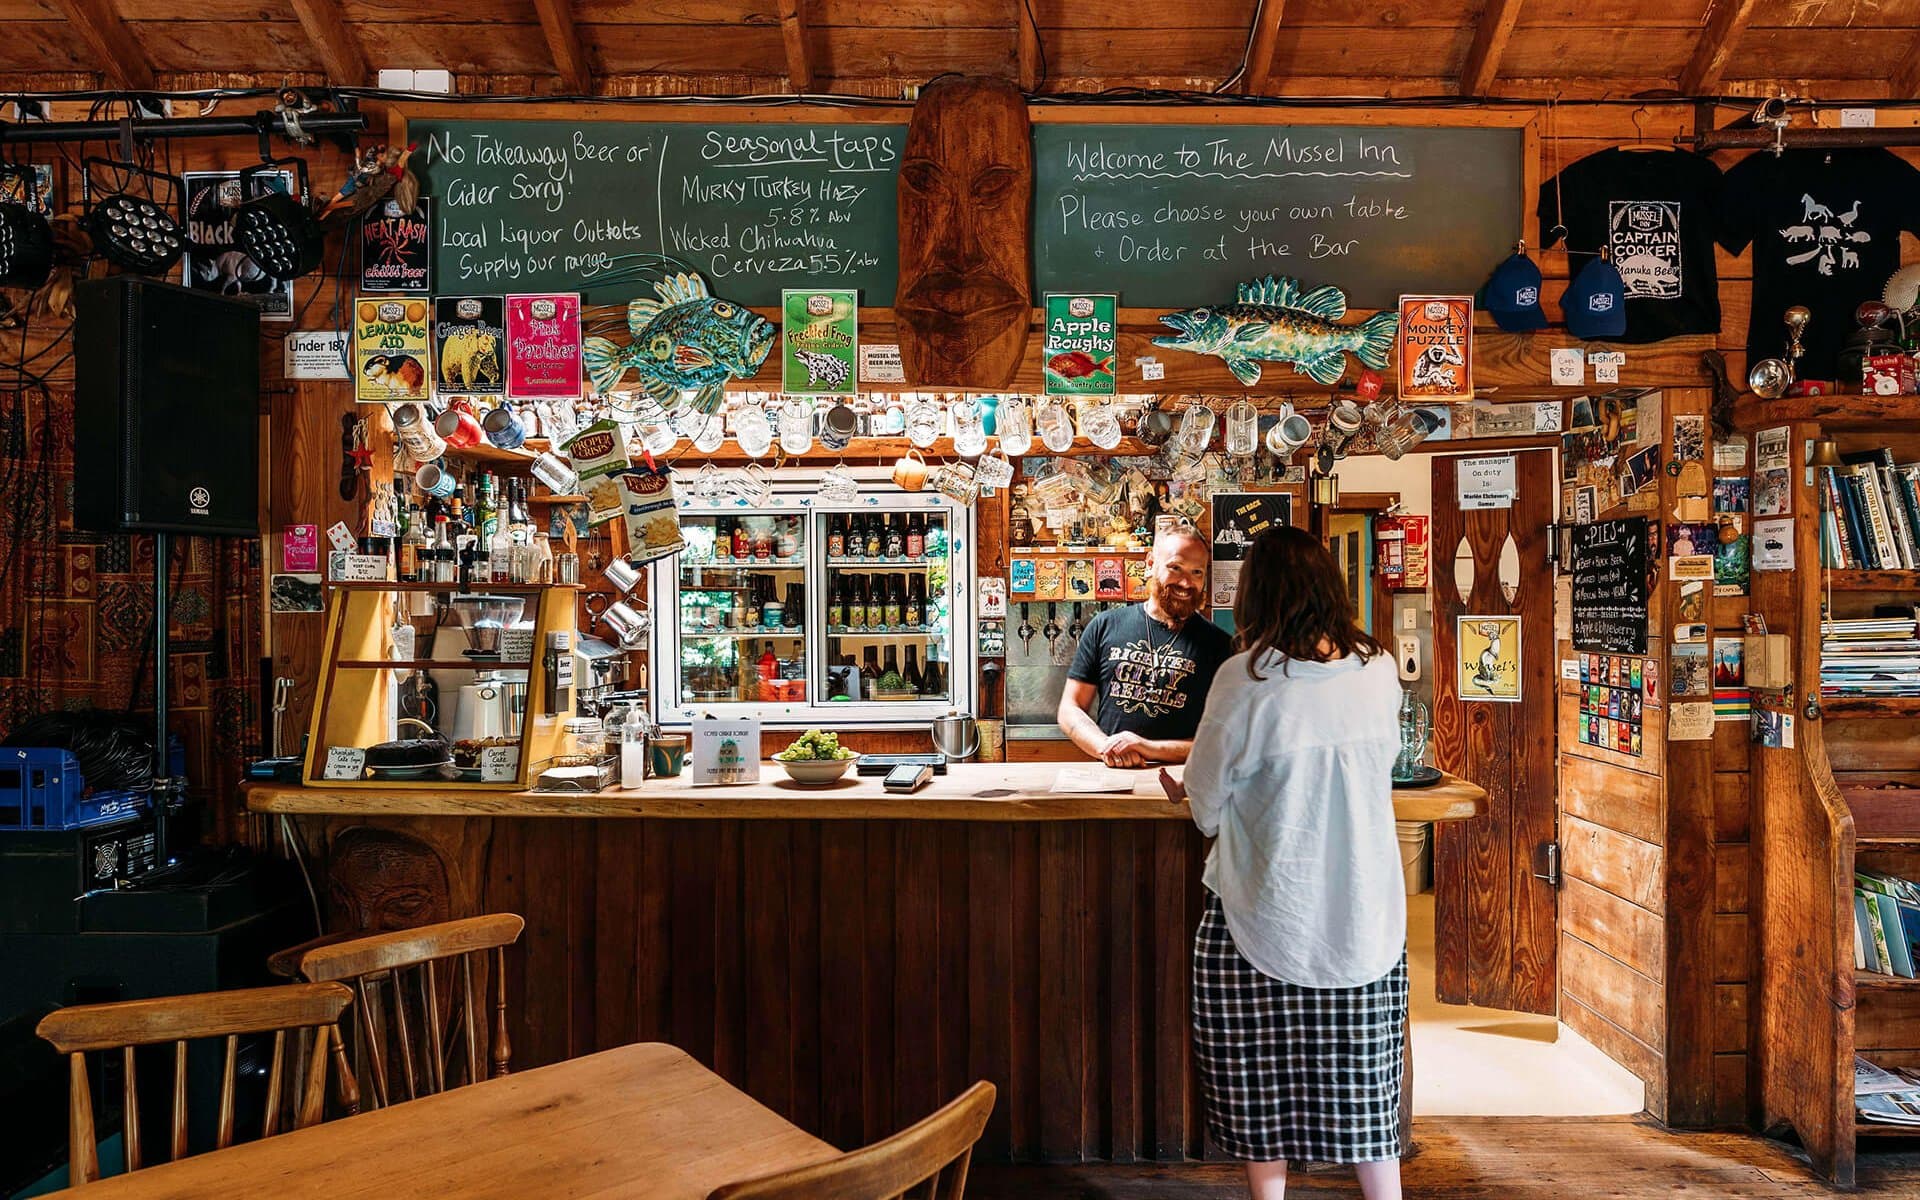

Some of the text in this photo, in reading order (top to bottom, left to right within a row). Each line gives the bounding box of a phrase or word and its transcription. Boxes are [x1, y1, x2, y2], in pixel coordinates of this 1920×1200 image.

[426, 132, 649, 183] No Takeaway Beer or
[701, 131, 895, 170] Seasonal taps
[1067, 135, 1402, 173] Welcome to The Mussel Inn
[447, 171, 575, 212] Cider Sorry!
[682, 175, 866, 206] MURKY TURKEY HAZY
[1061, 191, 1409, 236] Please choose your own table
[189, 220, 235, 245] Black
[364, 218, 428, 243] HEAT RASH
[442, 218, 642, 256] Local Liquor Outlets
[670, 224, 838, 252] Wicked Chihuahua
[1612, 231, 1679, 245] CAPTAIN
[1118, 236, 1188, 264] Order
[1202, 239, 1229, 261] at
[1247, 236, 1292, 258] the
[1308, 234, 1360, 260] Bar
[1614, 244, 1677, 257] COOKER
[401, 262, 427, 278] beer
[459, 251, 613, 279] Supply our range
[711, 253, 803, 279] Cerveza
[1654, 265, 1680, 276] Beer
[358, 322, 426, 340] LEMMING
[436, 321, 475, 340] Ginger
[530, 319, 561, 336] Pink
[787, 323, 853, 347] Freckled Frog
[1051, 318, 1112, 336] Apple
[1407, 325, 1465, 334] MONKEY
[289, 339, 325, 352] Under
[380, 335, 405, 349] AID
[512, 337, 577, 360] Panther
[1047, 334, 1114, 353] Roughy
[1406, 335, 1465, 345] PUZZLE
[1478, 458, 1511, 466] manager
[1484, 469, 1502, 477] duty
[1865, 484, 1879, 516] WORLD
[1589, 520, 1617, 544] PIES
